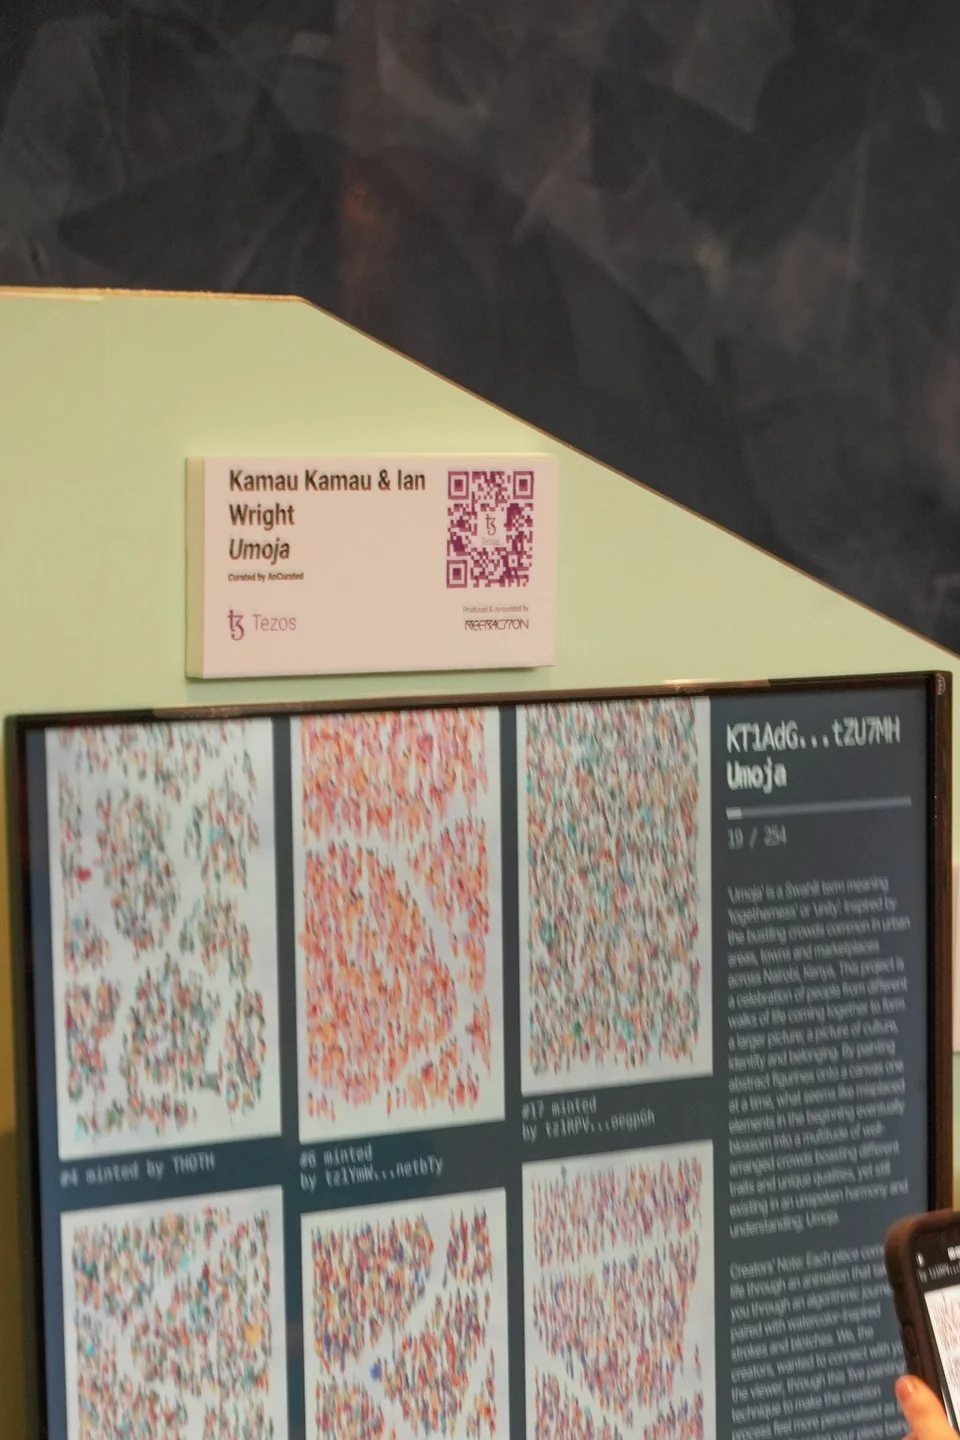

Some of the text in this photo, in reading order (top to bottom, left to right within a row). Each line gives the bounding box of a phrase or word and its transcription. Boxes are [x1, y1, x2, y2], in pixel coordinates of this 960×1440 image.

[229, 469, 425, 491] Kamau Kamau & Ian
[229, 503, 295, 531] Wright
[229, 538, 290, 566] Umoja
[228, 573, 256, 582] Curated
[257, 572, 265, 583] by
[252, 614, 297, 632] Tezos
[465, 618, 529, 631] REFRACTION
[727, 756, 787, 794] Umoja
[551, 1094, 596, 1118] minted
[522, 1120, 537, 1144] by
[324, 1142, 373, 1166] minted
[85, 1162, 139, 1185] minted
[146, 1158, 164, 1181] by
[300, 1171, 316, 1193] by
